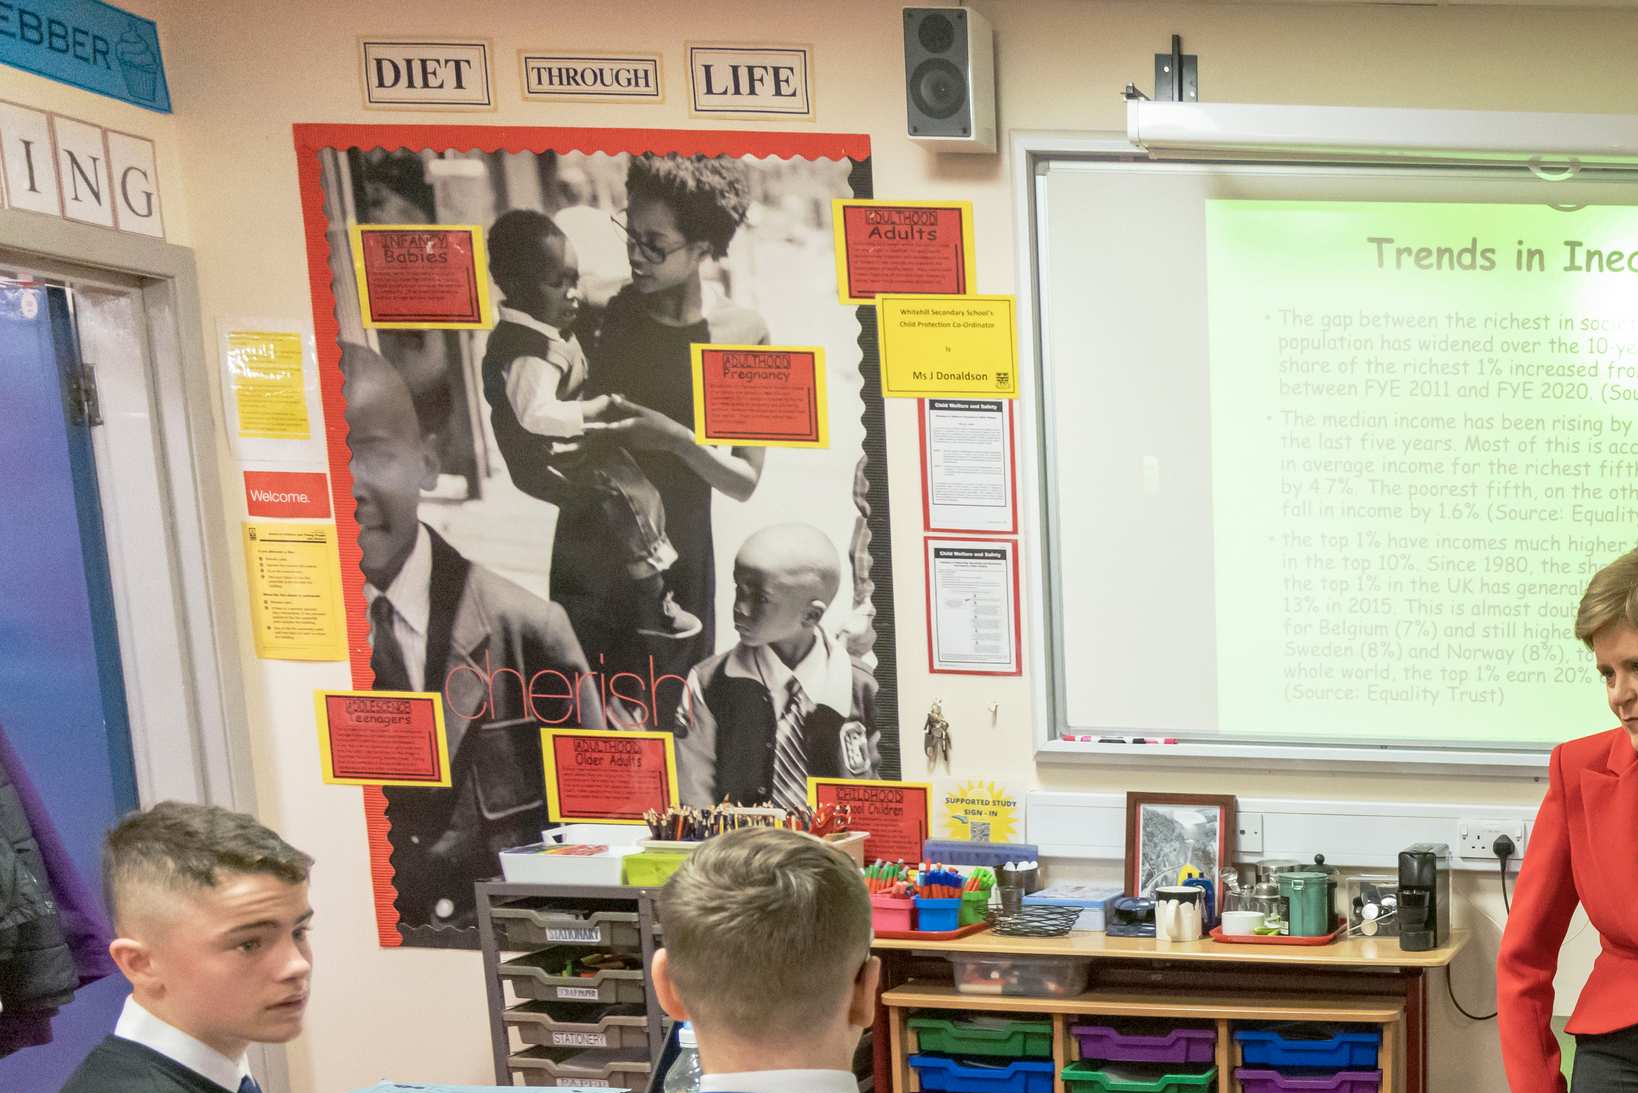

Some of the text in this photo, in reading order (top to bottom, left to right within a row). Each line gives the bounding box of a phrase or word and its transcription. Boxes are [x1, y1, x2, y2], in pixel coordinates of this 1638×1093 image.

[374, 57, 472, 90] DIET
[531, 66, 652, 89] THROUGH
[702, 63, 798, 97] LIFE
[867, 227, 938, 241] Adults
[384, 250, 448, 263] Babies
[1367, 237, 1497, 272] Trends
[1515, 240, 1545, 272] in
[1278, 309, 1312, 327] The
[1321, 313, 1353, 331] gap
[1360, 310, 1438, 328] between
[1446, 312, 1477, 329] the
[1484, 313, 1551, 331] richest
[1559, 314, 1574, 331] in
[1278, 330, 1373, 354] population
[1380, 334, 1411, 352] has
[1418, 335, 1494, 352] widened
[1500, 339, 1542, 353] over
[1549, 337, 1579, 354] the
[723, 369, 791, 382] Pregnancy
[913, 371, 988, 382] Ms J Donaldson
[1279, 356, 1332, 374] share
[1338, 355, 1359, 374] of
[1365, 358, 1396, 375] the
[1403, 357, 1470, 376] richest
[1478, 358, 1502, 376] 1%
[1510, 361, 1598, 378] increased
[1279, 378, 1358, 396] between
[1364, 379, 1401, 397] FYE
[1409, 380, 1449, 397] 2011
[1457, 381, 1489, 398] and
[1497, 382, 1533, 399] FYE
[1541, 383, 1593, 400] 2020.
[1279, 410, 1317, 427] The
[1322, 411, 1388, 428] median
[1394, 413, 1456, 429] income
[1463, 412, 1494, 430] has
[1501, 412, 1545, 431] been
[1552, 415, 1602, 435] rising
[1610, 416, 1632, 436] by
[1279, 432, 1311, 449] the
[1318, 432, 1352, 450] last
[1360, 434, 1396, 451] five
[1402, 438, 1457, 455] years.
[1465, 436, 1510, 453] Most
[1517, 435, 1537, 453] of
[1545, 436, 1581, 454] this
[1588, 438, 1602, 454] is
[1280, 455, 1297, 472] in
[1302, 458, 1375, 477] average
[1382, 458, 1445, 475] income
[1452, 457, 1480, 475] for
[1487, 458, 1519, 476] the
[1525, 459, 1591, 477] richest
[250, 490, 311, 504] Welcome.
[445, 650, 693, 729] cherish
[610, 755, 641, 767] Adults
[868, 803, 904, 816] Children
[945, 797, 1017, 807] SUPPORTED STUDY
